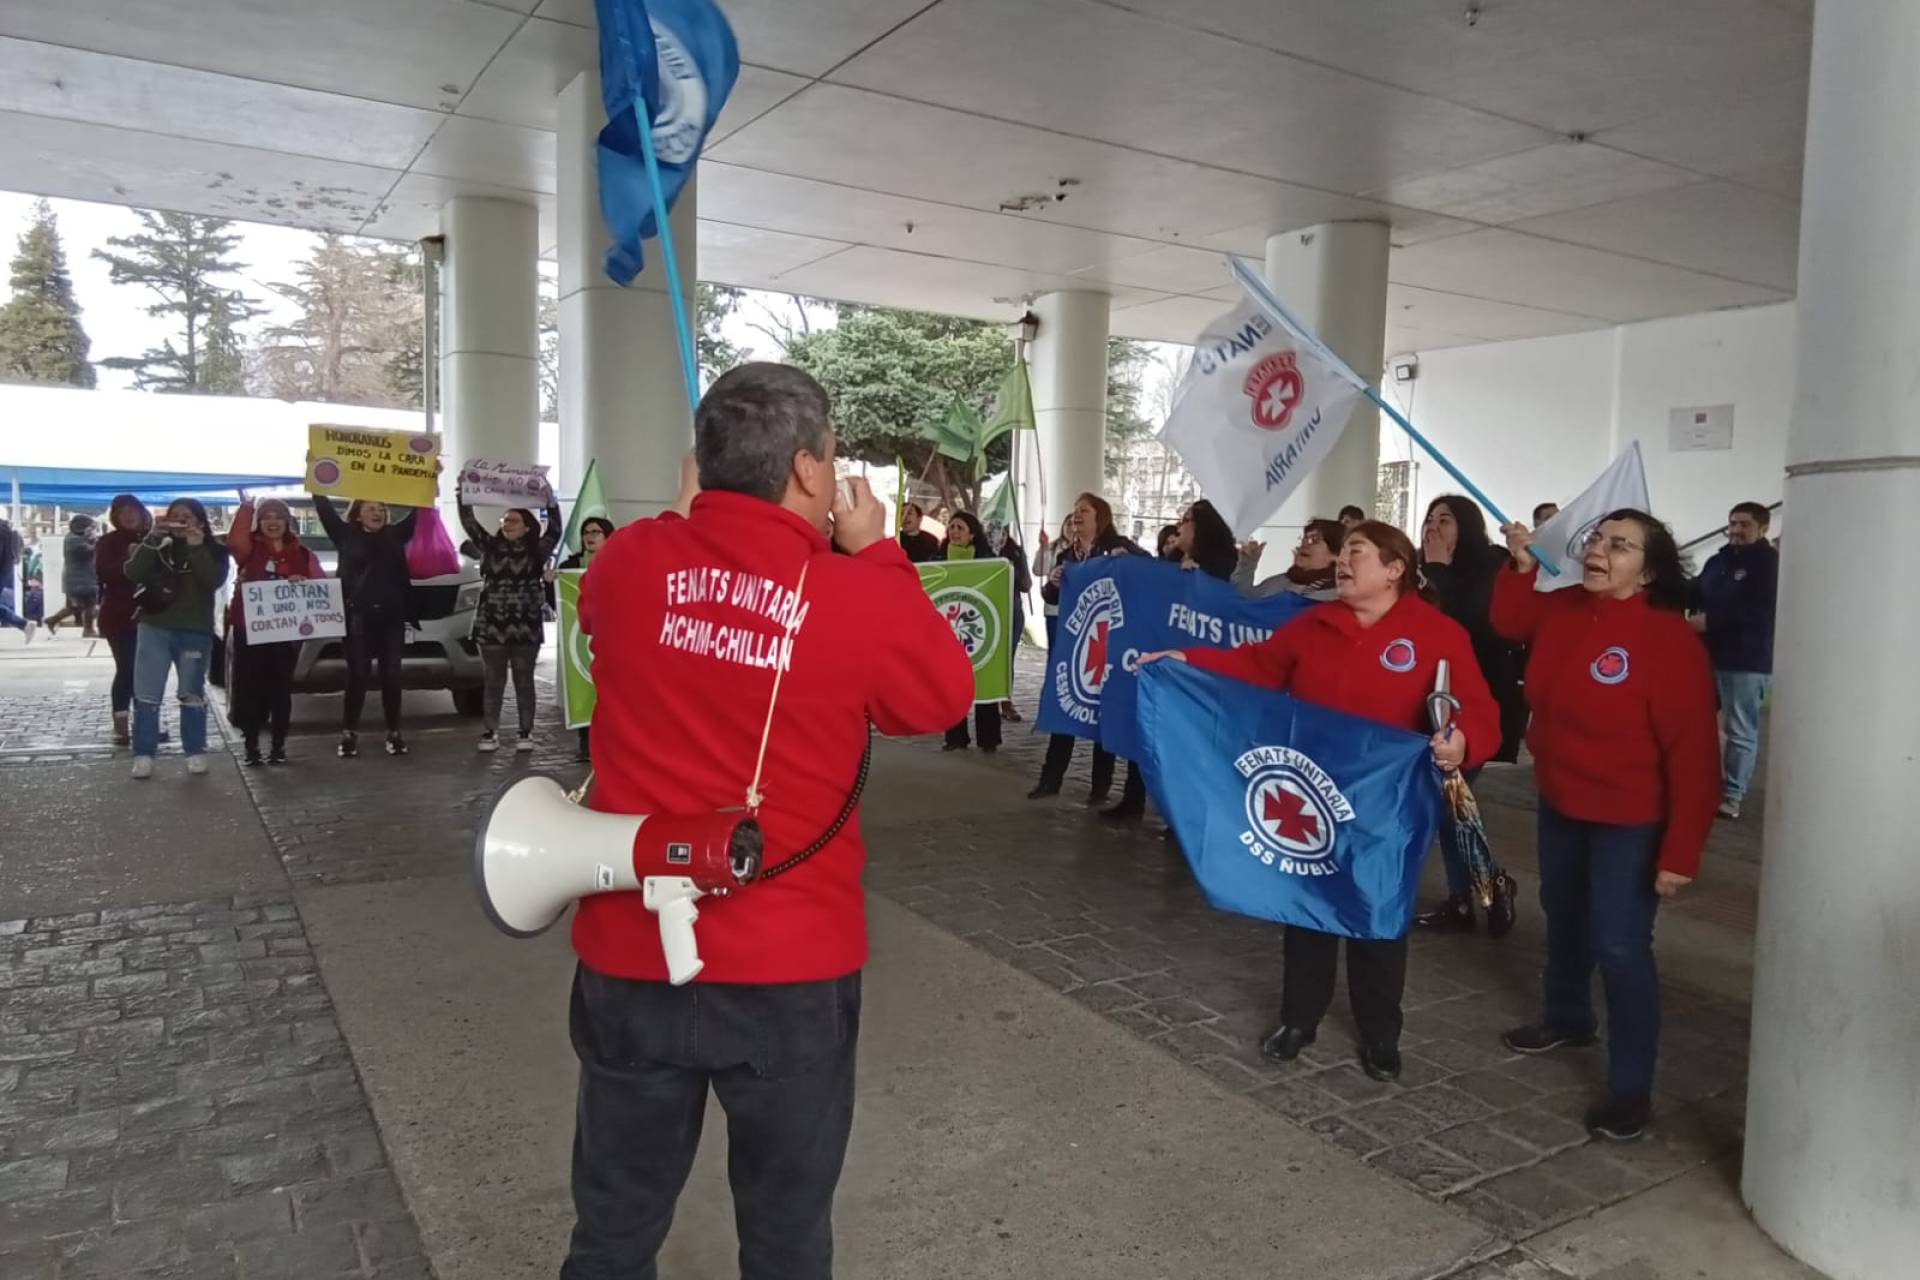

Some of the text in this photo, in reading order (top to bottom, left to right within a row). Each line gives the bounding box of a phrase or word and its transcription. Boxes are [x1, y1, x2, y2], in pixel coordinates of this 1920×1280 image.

[336, 446, 425, 465] DIMOS LA CARA
[351, 461, 366, 471] EN
[374, 463, 385, 473] LA
[249, 584, 329, 603] SI CORTAN
[666, 566, 811, 635] FENATS UNITARIA
[272, 601, 296, 614] UNO
[306, 599, 331, 611] NOS
[251, 616, 298, 633] CORTAN
[1237, 747, 1352, 820] FENATS UNITARIA
[1239, 830, 1275, 865] DSS
